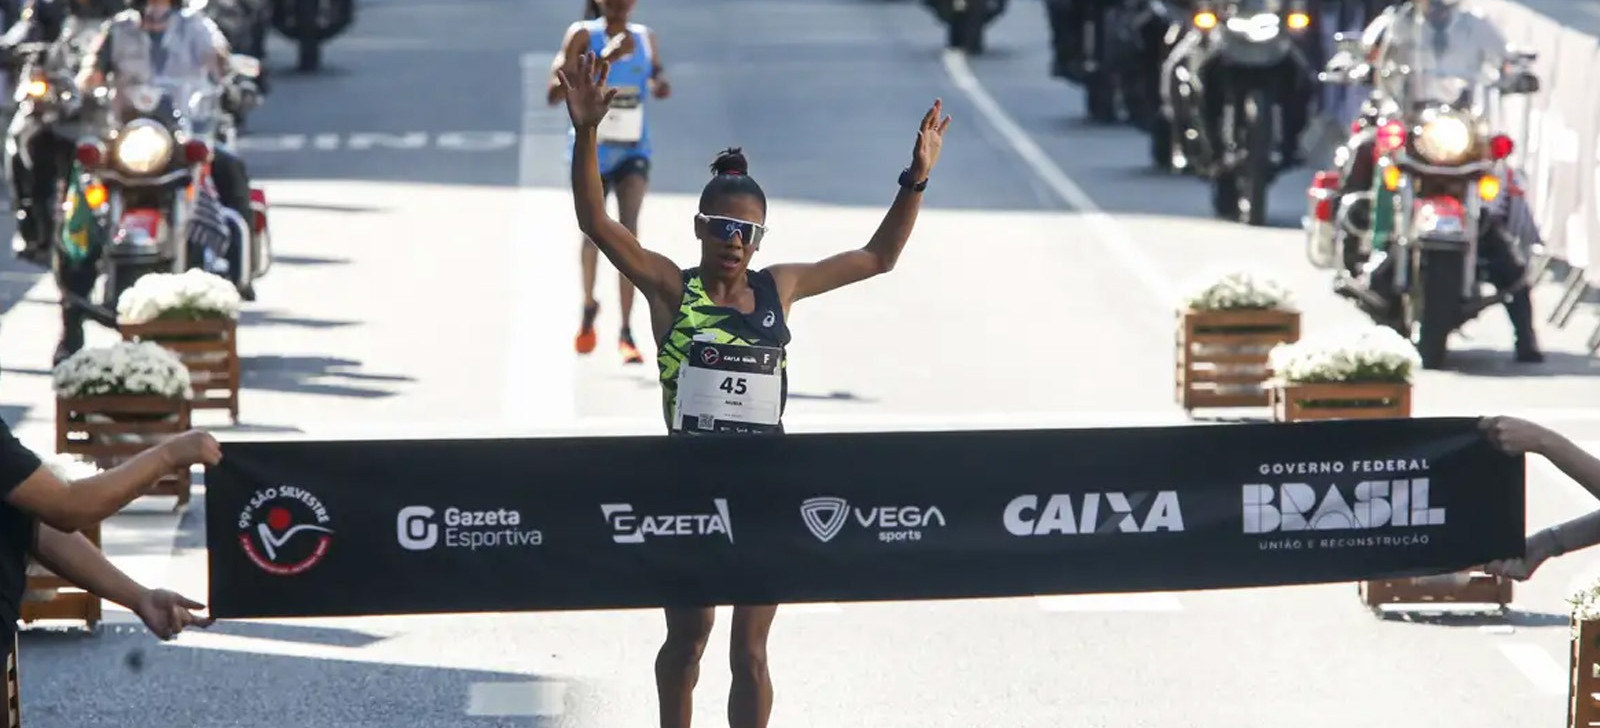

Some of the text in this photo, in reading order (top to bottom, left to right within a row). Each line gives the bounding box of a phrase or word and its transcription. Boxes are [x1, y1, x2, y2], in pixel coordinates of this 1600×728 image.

[720, 377, 747, 395] 45
[1259, 458, 1430, 475] GOVERNO FEDERAL
[250, 488, 277, 509] SÃO
[279, 485, 330, 523] SILVESTRE
[1003, 490, 1184, 536] CAIXA
[1242, 477, 1446, 534] BRASIL
[444, 507, 520, 526] Gazeta
[854, 505, 946, 528] VEGA
[445, 527, 542, 550] Esportiva
[878, 530, 921, 542] sports
[1259, 541, 1301, 550] UNIÃO
[1320, 534, 1430, 548] RECONSTRUÇÃO
